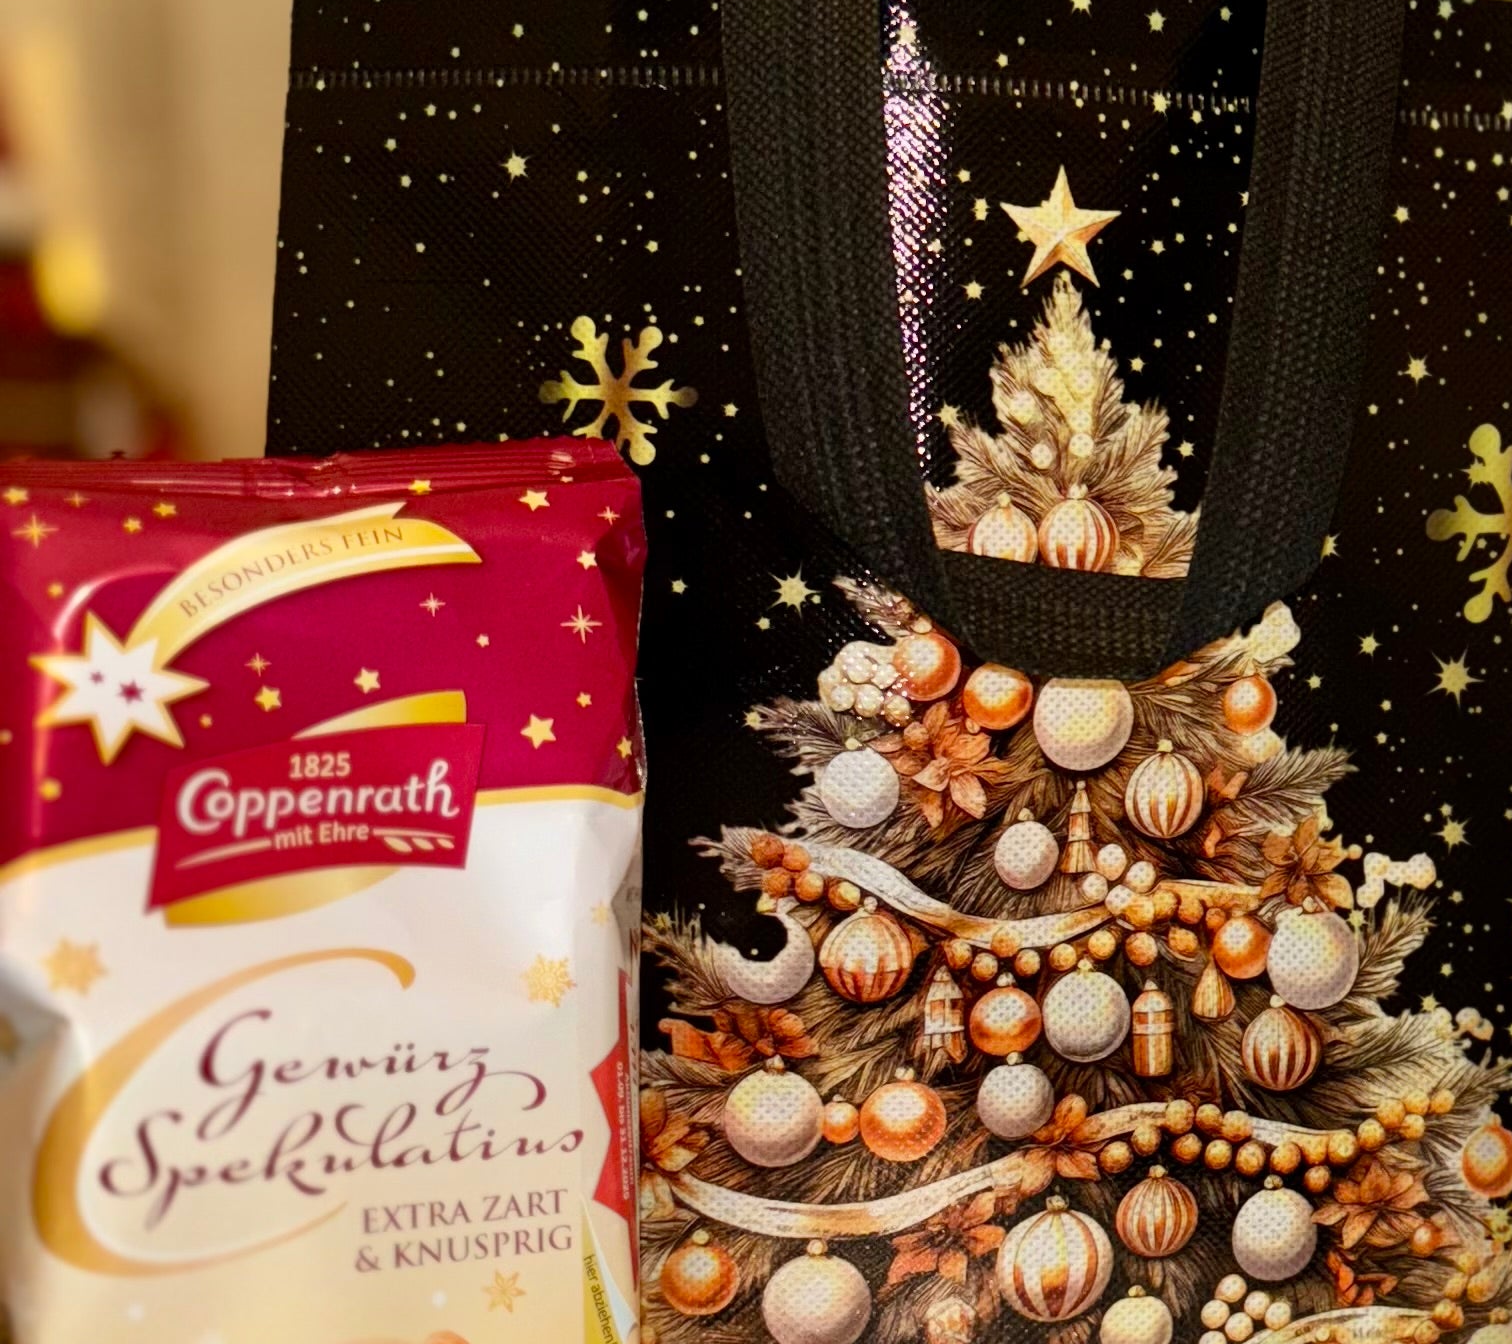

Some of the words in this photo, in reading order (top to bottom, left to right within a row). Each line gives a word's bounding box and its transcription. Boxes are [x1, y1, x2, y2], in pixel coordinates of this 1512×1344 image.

[180, 538, 333, 617] BESONDERS
[341, 527, 403, 550] FEIN
[289, 752, 351, 779] 1825
[176, 759, 460, 837] Coppenrath
[274, 824, 312, 850] mit
[319, 821, 369, 844] Ehre
[193, 1008, 546, 1141] Gewürz
[98, 1102, 584, 1231] Spekulatius
[362, 1200, 472, 1235] EXTRA
[482, 1188, 568, 1222] ZART
[355, 1245, 381, 1273] &
[393, 1224, 572, 1269] KNUSPRIG
[583, 1254, 598, 1281] hier
